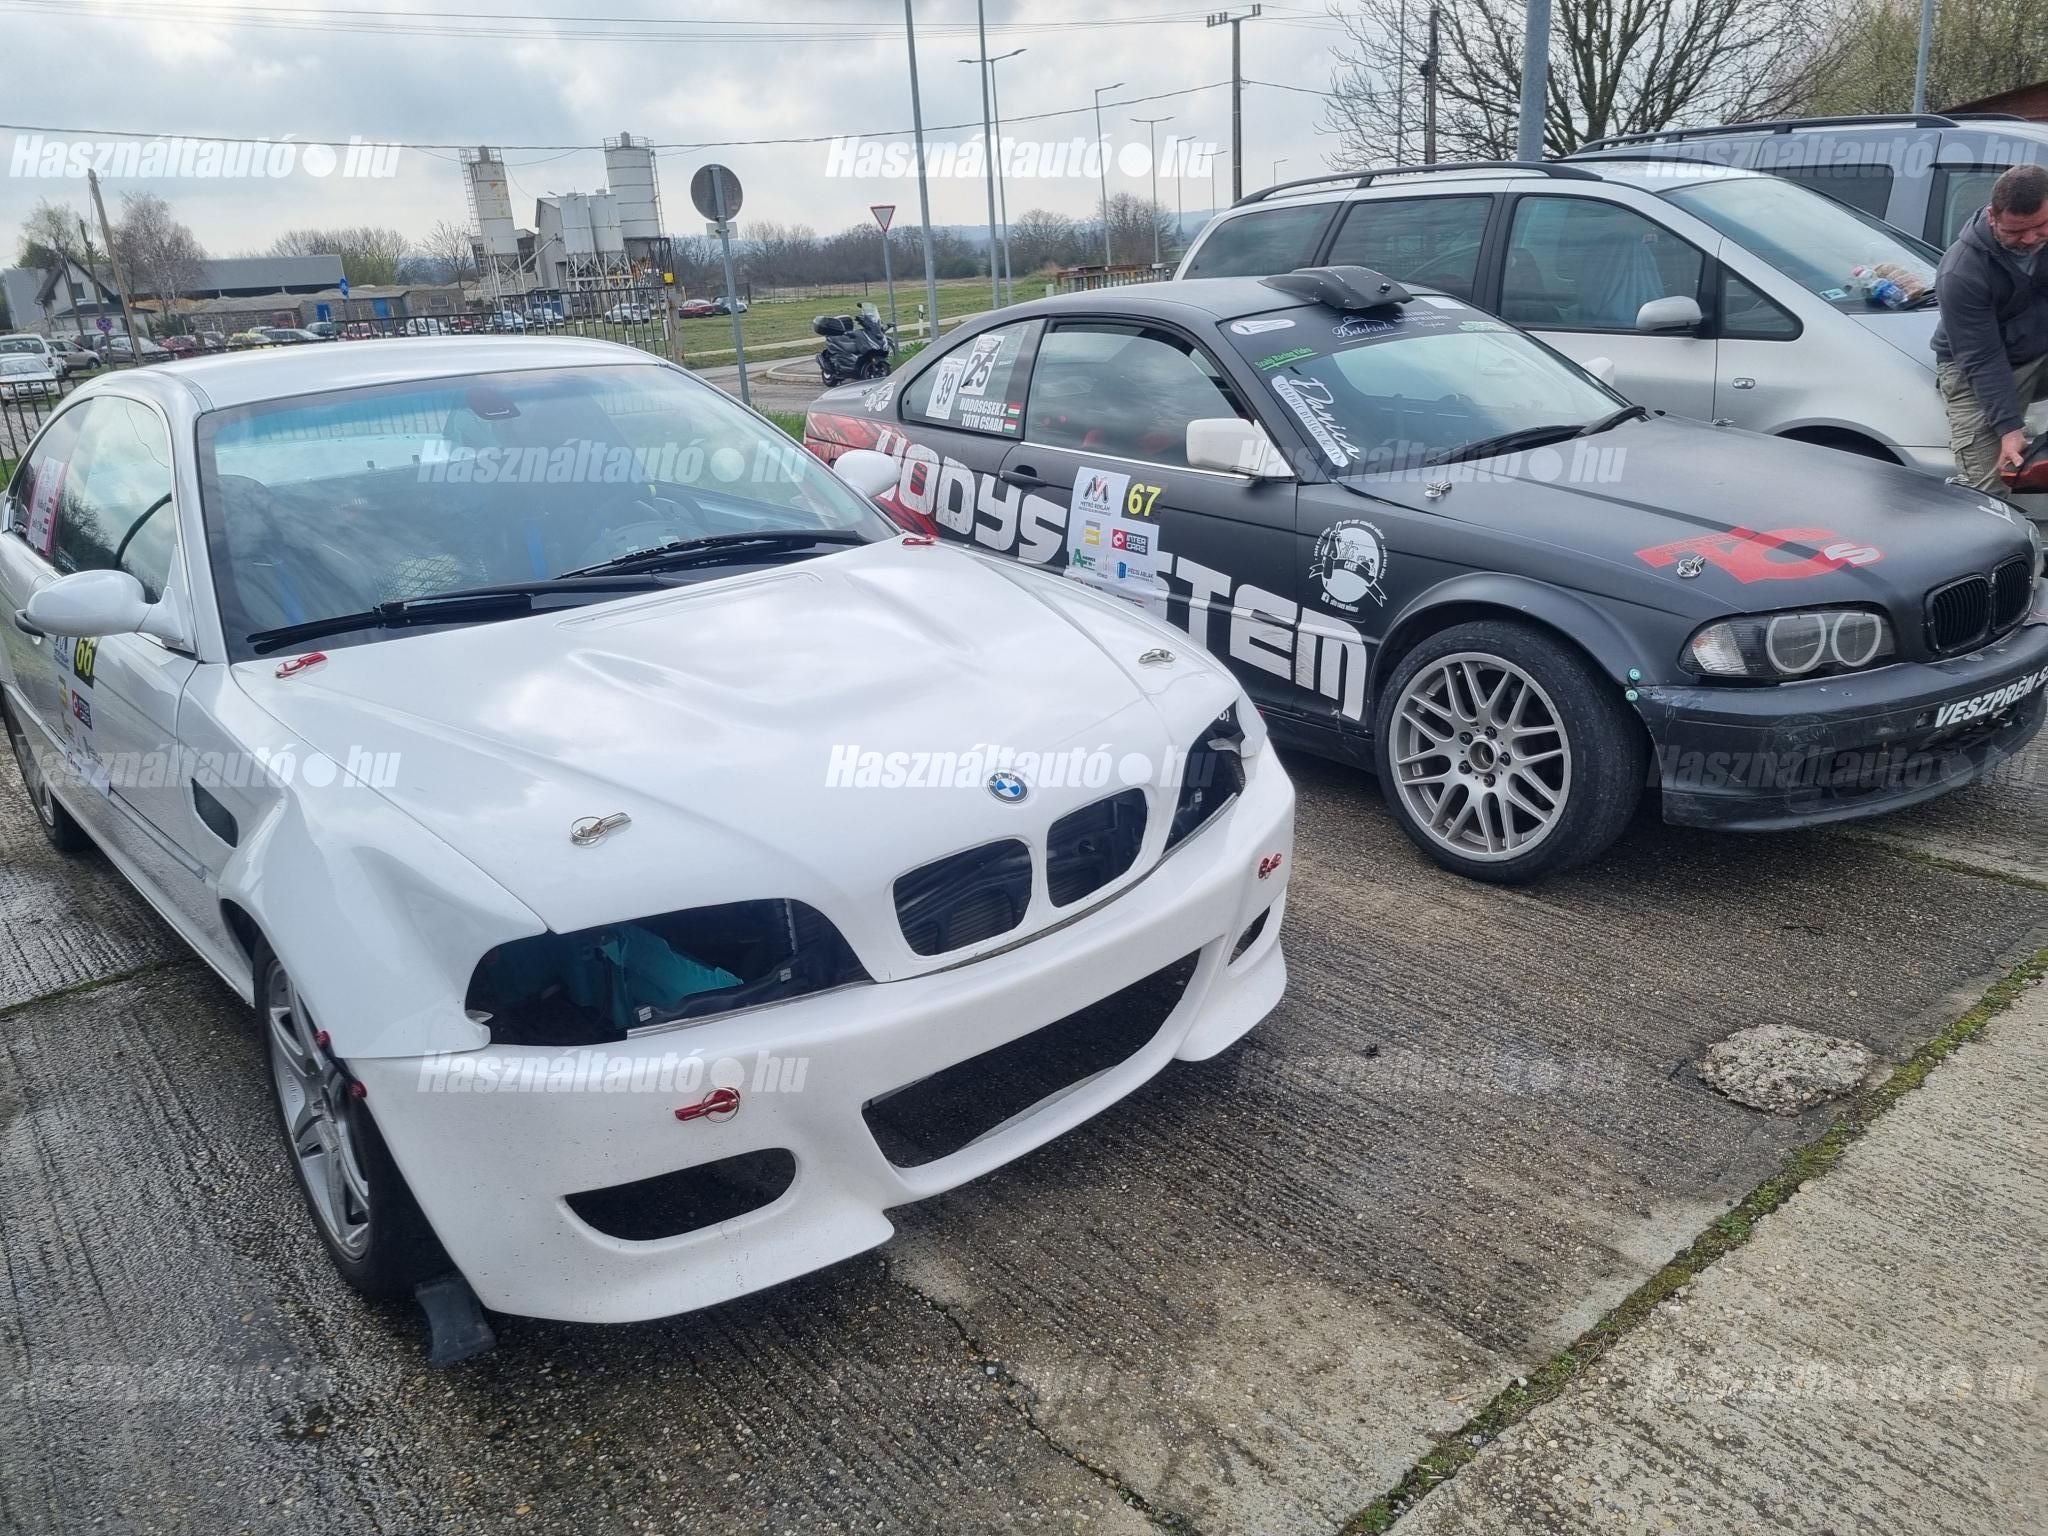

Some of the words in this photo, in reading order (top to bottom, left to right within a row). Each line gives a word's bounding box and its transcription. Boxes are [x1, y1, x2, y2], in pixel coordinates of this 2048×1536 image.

[1128, 483, 1161, 517] 67
[1126, 534, 1147, 546] INTER
[1126, 542, 1147, 553] CARS
